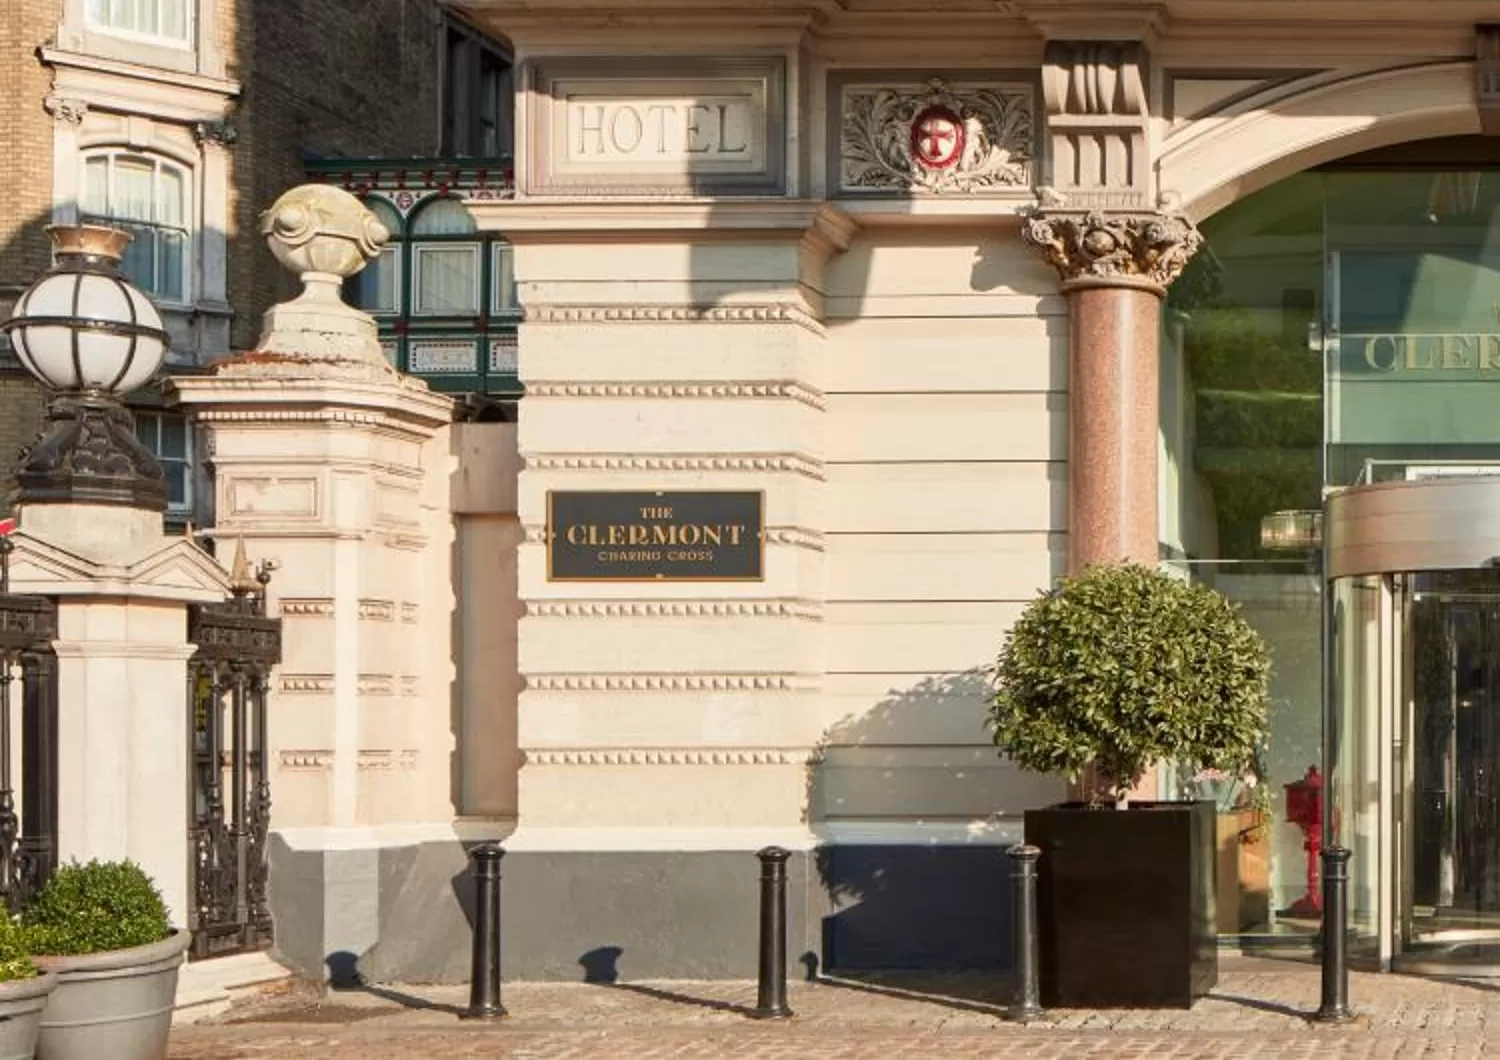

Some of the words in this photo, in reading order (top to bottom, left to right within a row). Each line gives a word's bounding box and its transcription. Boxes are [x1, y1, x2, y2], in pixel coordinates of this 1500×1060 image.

[575, 104, 748, 155] HOTEL
[640, 507, 673, 520] THE
[567, 524, 746, 546] CLERMONT
[597, 550, 662, 562] CHARING
[666, 550, 714, 562] CROSS
